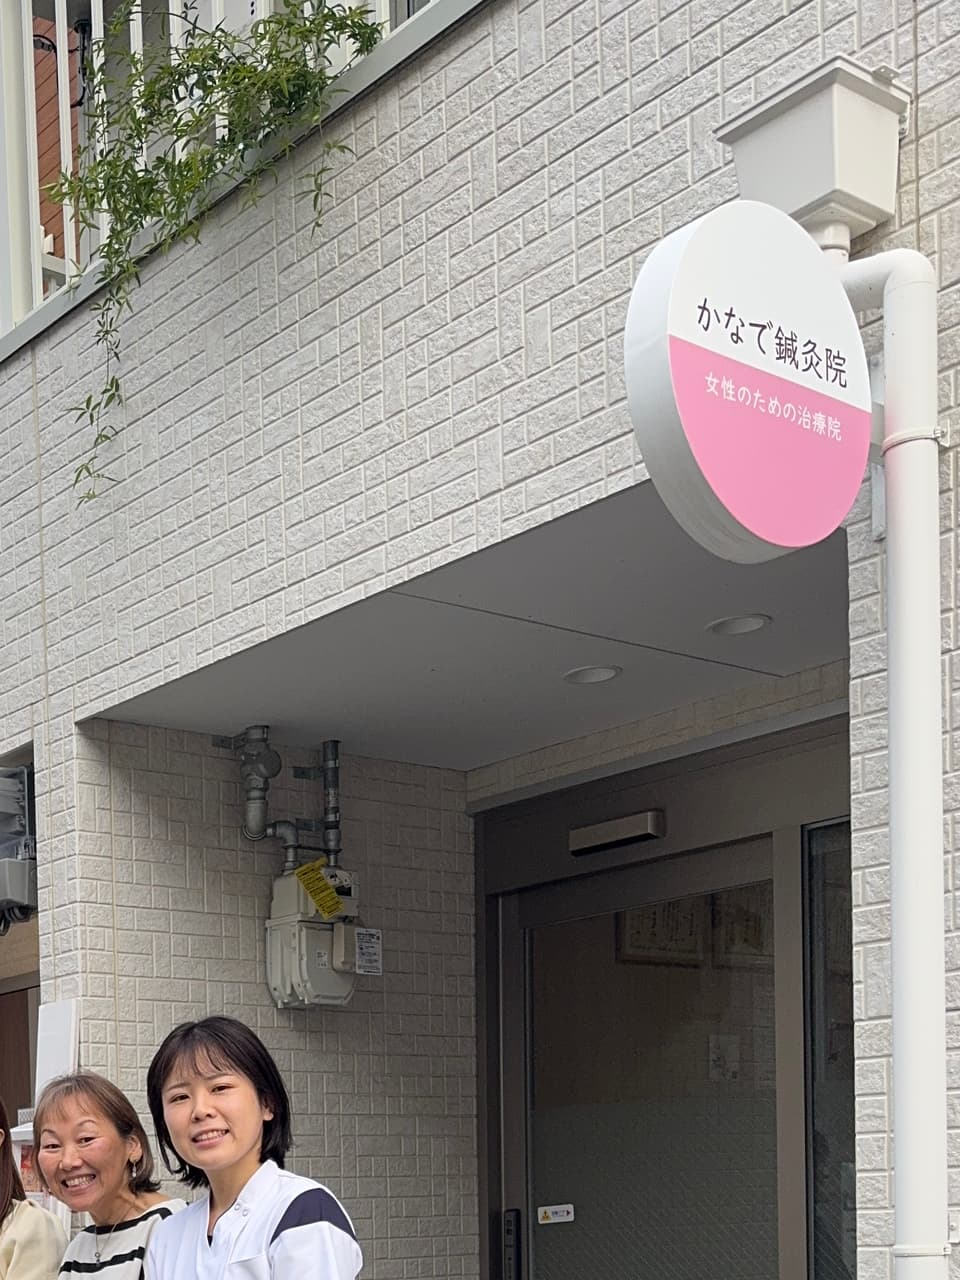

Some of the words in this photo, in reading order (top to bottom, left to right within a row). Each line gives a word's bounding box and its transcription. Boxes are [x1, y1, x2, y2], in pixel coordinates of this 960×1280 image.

[696, 298, 847, 388] かなで鍼灸院
[704, 371, 842, 441] 女性のための治療院
